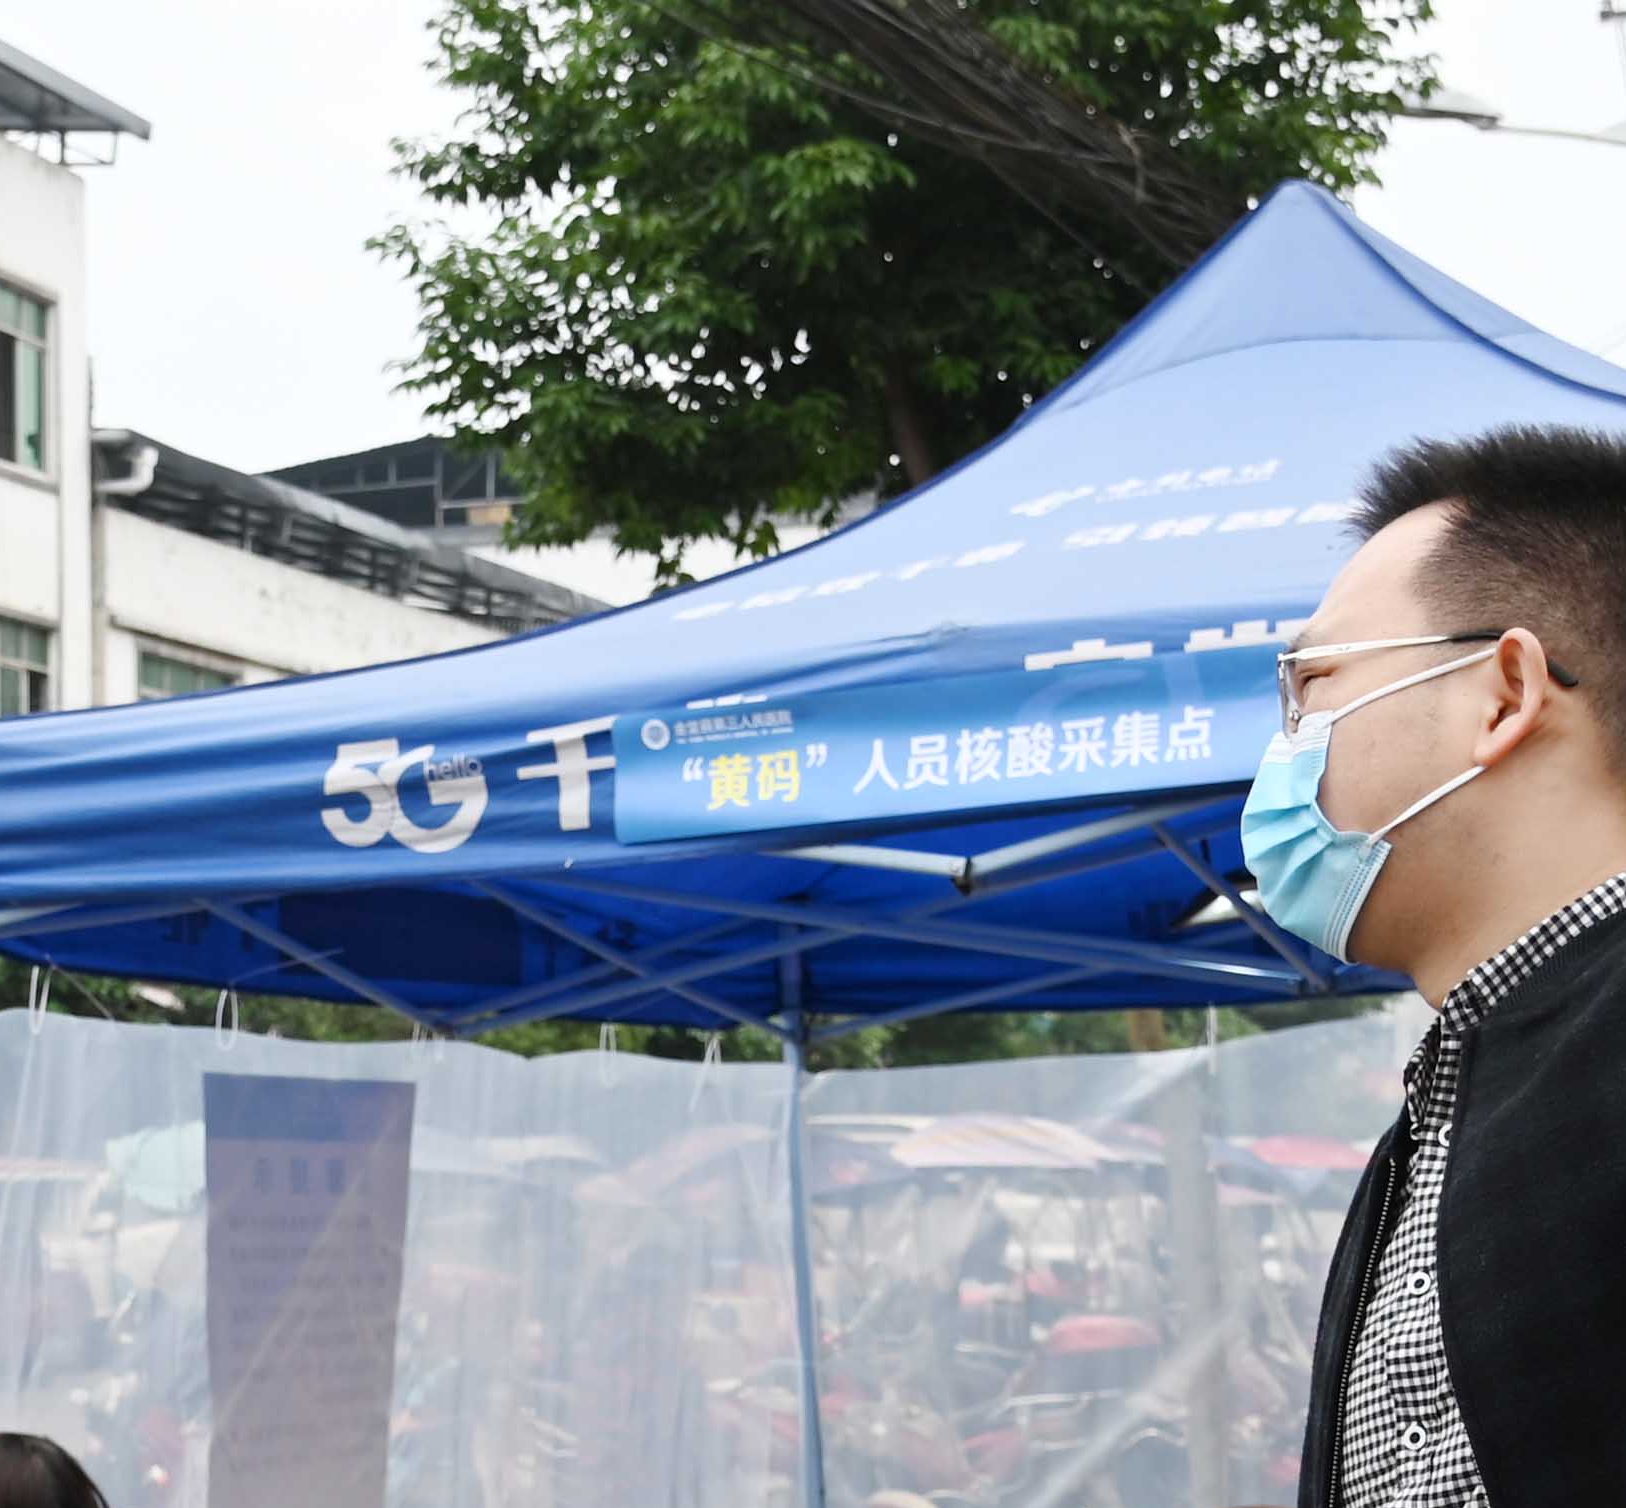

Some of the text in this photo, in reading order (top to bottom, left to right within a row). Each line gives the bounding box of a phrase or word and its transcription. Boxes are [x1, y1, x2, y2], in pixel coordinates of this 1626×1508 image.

[321, 738, 488, 853] 5G
[427, 752, 483, 783] hello
[682, 705, 1215, 811] “黄码” 人员核酸采集点
